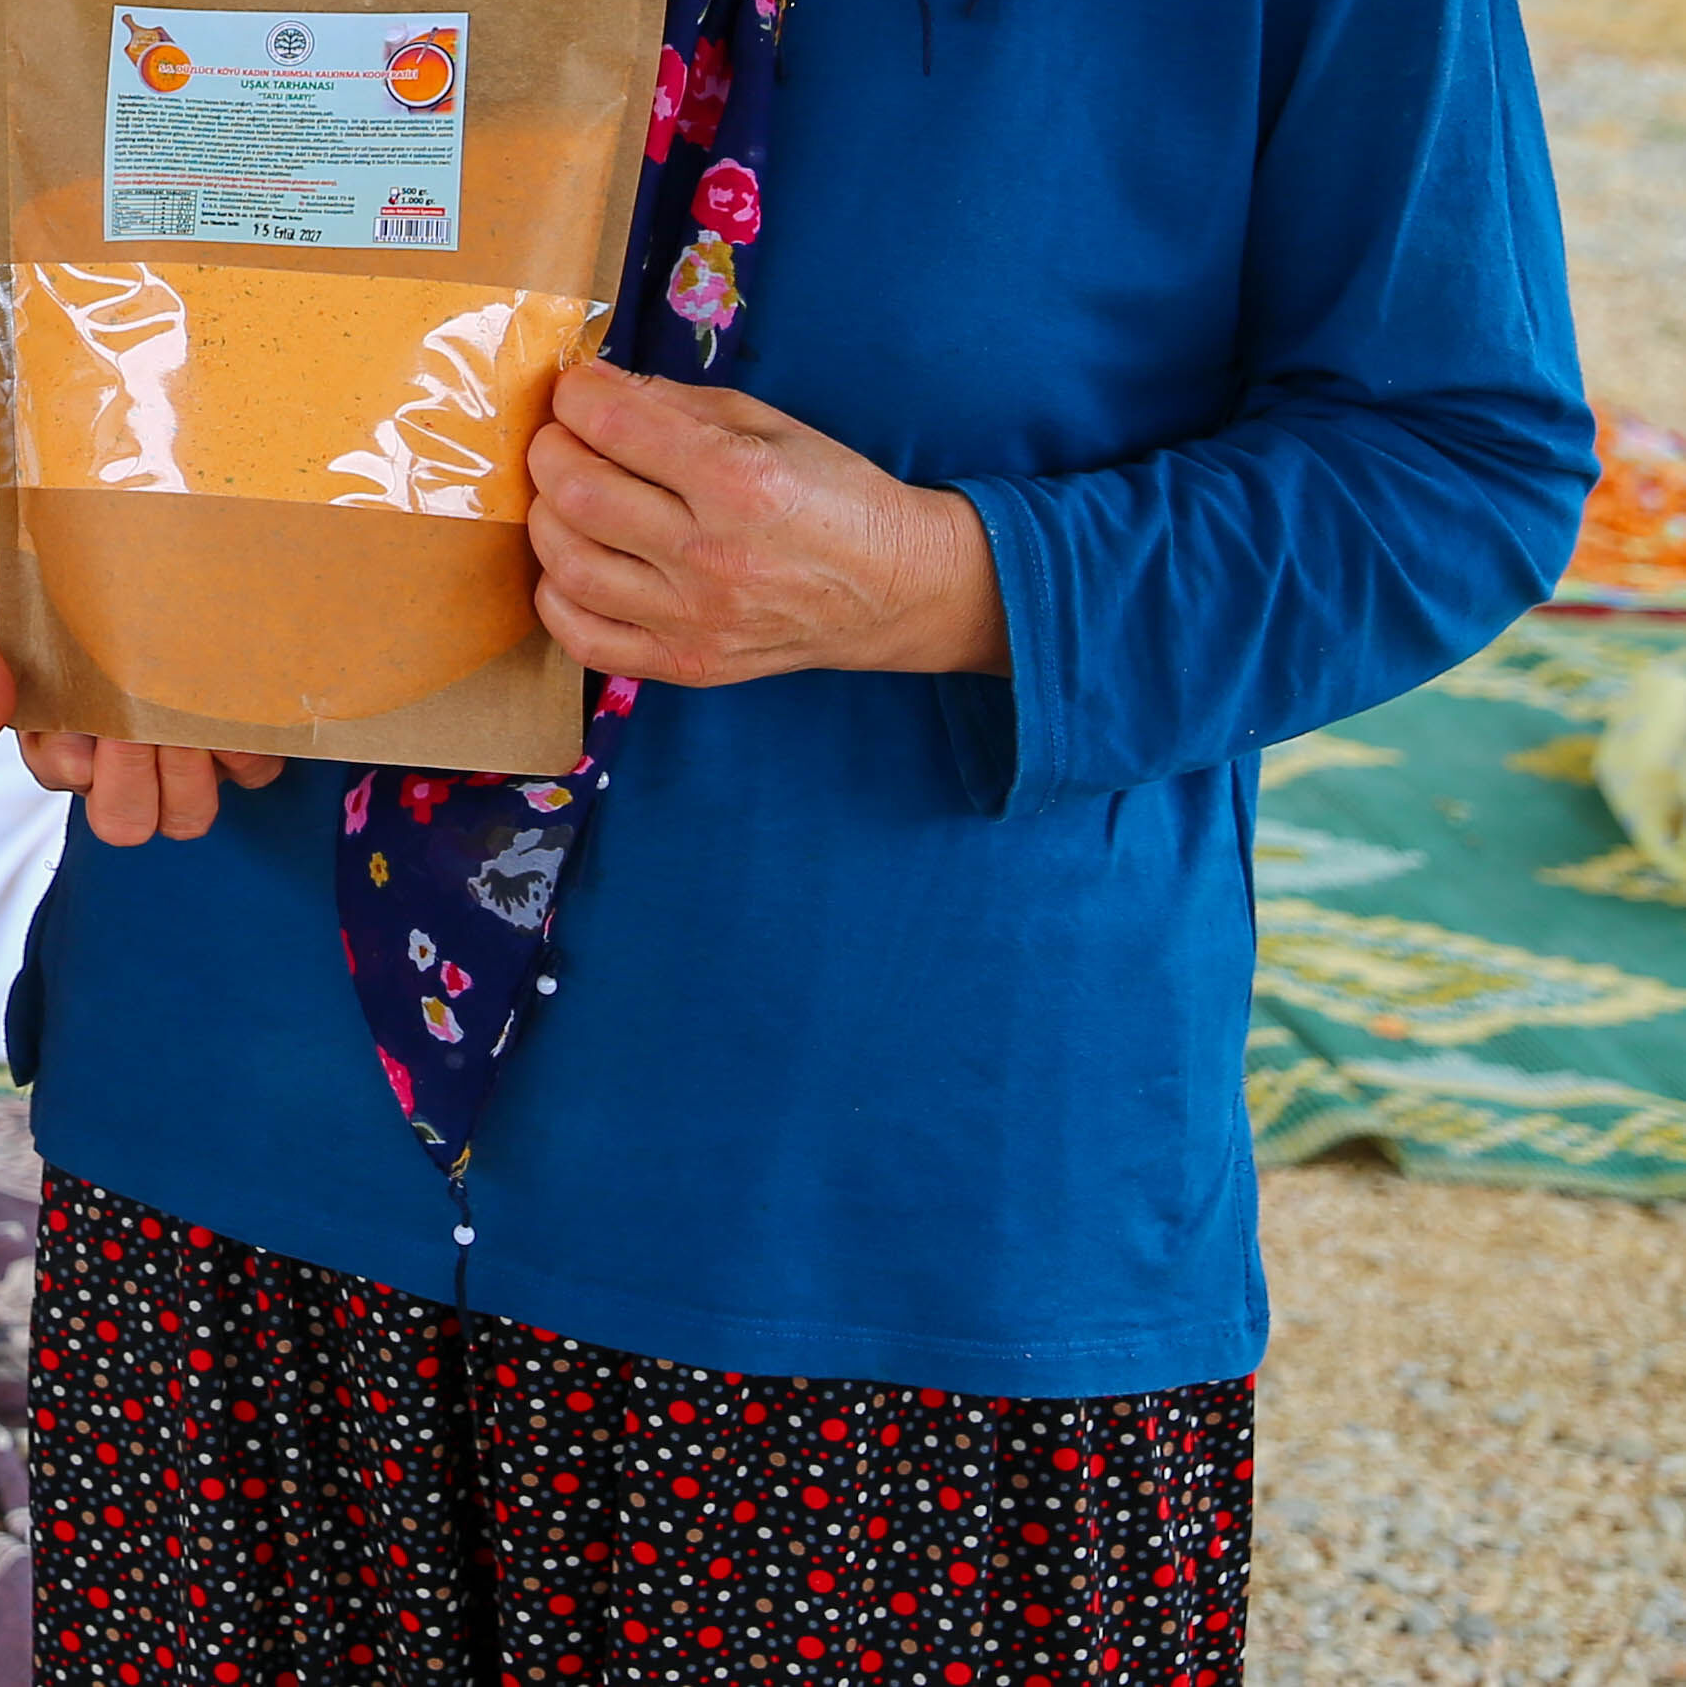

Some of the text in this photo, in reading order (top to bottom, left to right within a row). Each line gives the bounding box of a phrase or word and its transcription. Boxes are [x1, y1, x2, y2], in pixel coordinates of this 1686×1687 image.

[217, 66, 240, 76] KÖYÜ
[242, 69, 270, 77] KADIN
[272, 69, 313, 78] TARIMSAL
[315, 70, 359, 79] KALKINMA
[240, 80, 334, 90] UŞAK TARHANASI
[402, 187, 417, 195] 500
[402, 196, 424, 205] 1.000
